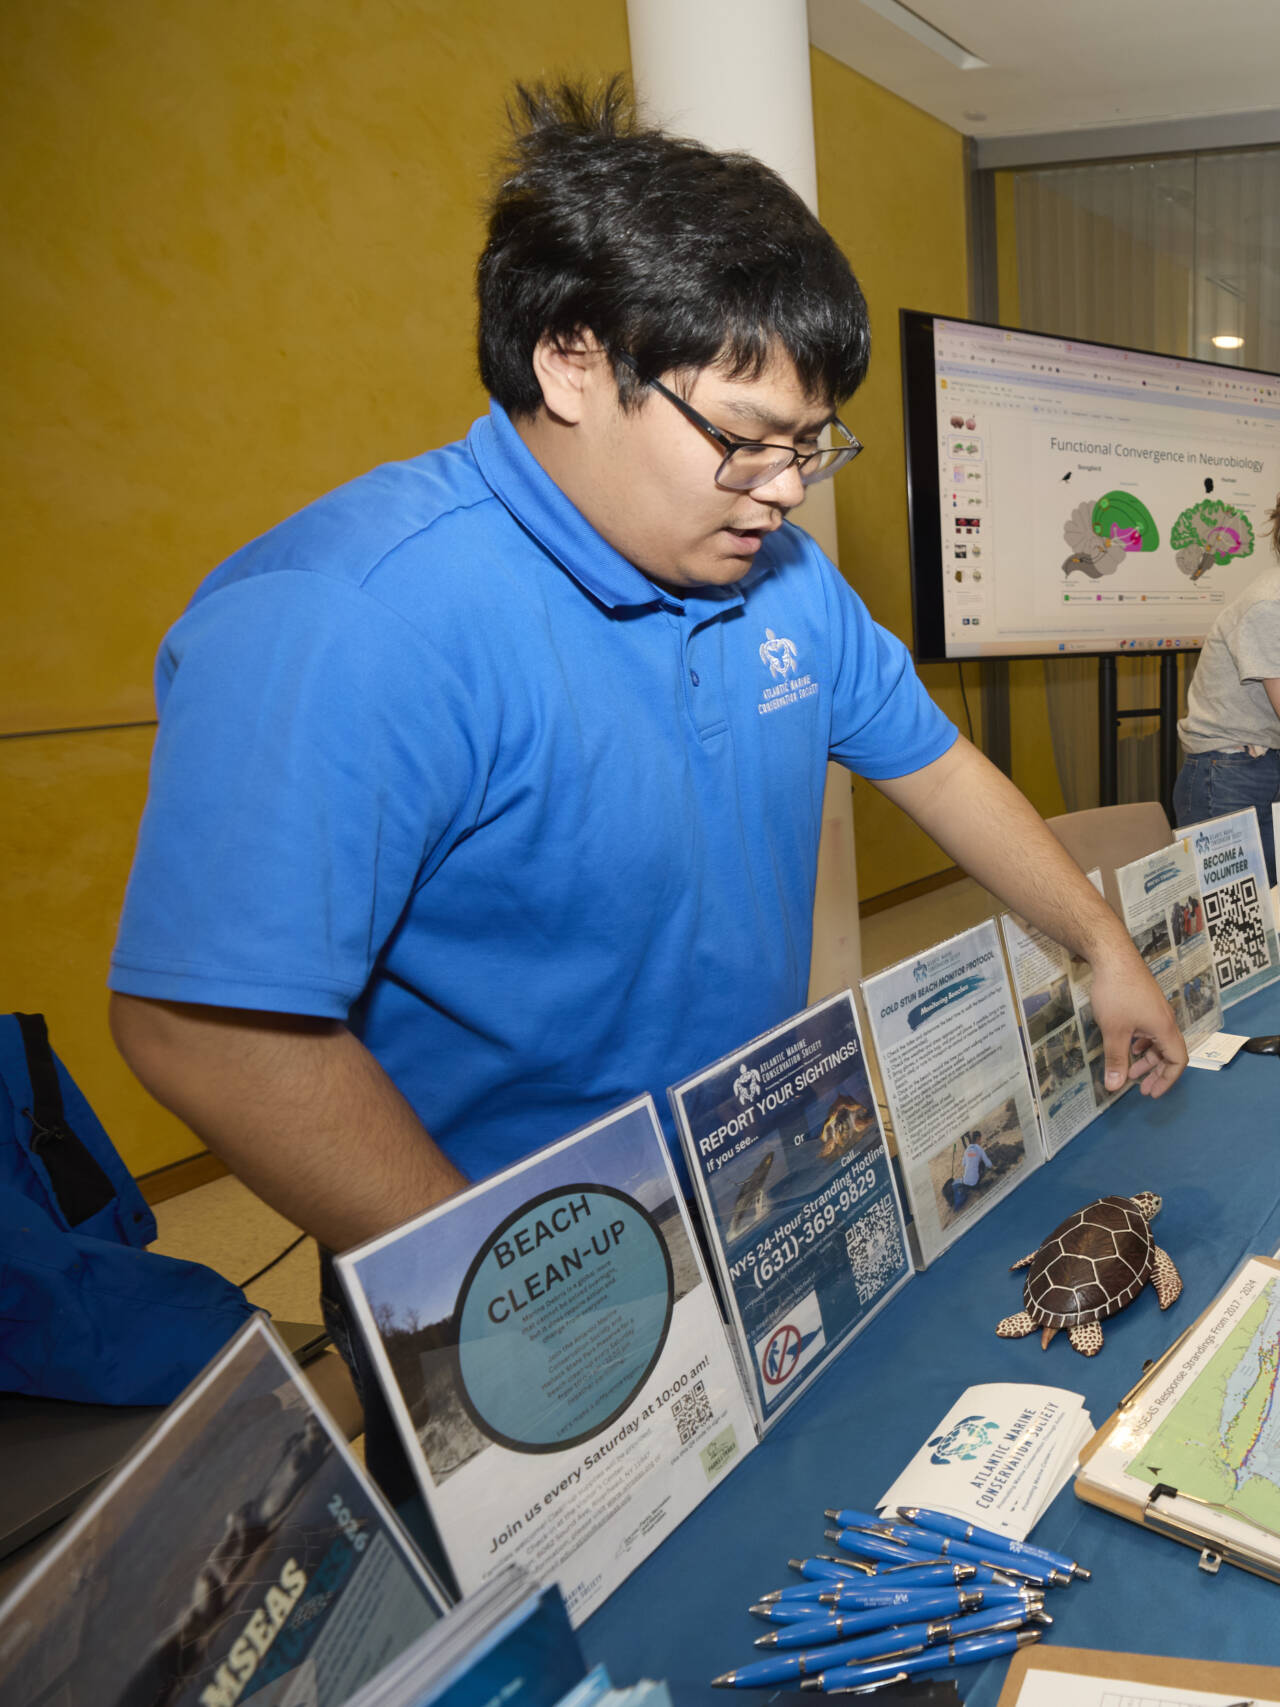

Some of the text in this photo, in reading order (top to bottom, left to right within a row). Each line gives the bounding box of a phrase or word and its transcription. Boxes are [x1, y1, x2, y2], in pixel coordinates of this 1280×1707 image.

[1050, 437, 1264, 472] Functional Convergence in Neurobiology
[758, 683, 818, 714] CONSERVATION SOCIETY
[763, 675, 811, 699] ATLANTIC MARINE
[1203, 846, 1244, 870] BECOME A
[1204, 859, 1248, 885] VOLUNTEER
[879, 1000, 899, 1019] COLD
[898, 990, 917, 1009] STUN
[916, 979, 939, 999] BEACH
[936, 964, 965, 987] MONITOR
[964, 948, 994, 972] PROTOCOL
[919, 982, 969, 1017] Monitoring Beaches
[758, 1050, 785, 1073] ATLANTIC
[785, 1036, 807, 1056] MARINE
[761, 1051, 801, 1083] CONSERVATION
[800, 1038, 822, 1059] SOCIETY
[698, 1105, 757, 1157] REPORT
[755, 1081, 794, 1119] YOUR
[792, 1037, 859, 1092] SIGHTINGS!
[705, 1129, 759, 1173] If you see...
[793, 1130, 806, 1148] Or
[839, 1144, 861, 1169] Call...
[492, 1192, 591, 1270] BEACH
[728, 1140, 885, 1282] NYS 24-Hour Stranding Hotline
[749, 1165, 878, 1291] (631)-369-9829
[484, 1216, 629, 1328] CLEAN-UP
[521, 1302, 545, 1324] Marine
[544, 1288, 567, 1309] Debris
[576, 1268, 596, 1287] global
[528, 1328, 542, 1343] but
[546, 1312, 564, 1330] does
[562, 1296, 587, 1319] require
[585, 1284, 605, 1303] action
[603, 1275, 617, 1290] and
[534, 1304, 559, 1327] cannot
[558, 1298, 568, 1311] be
[567, 1284, 589, 1304] solved
[541, 1322, 566, 1346] change
[1128, 1404, 1161, 1437] MSEAS
[1152, 1369, 1190, 1407] Response
[1180, 1333, 1218, 1371] Strandings
[1208, 1315, 1230, 1335] From
[1222, 1298, 1243, 1317] 2017
[1238, 1278, 1259, 1296] 2024
[486, 1514, 523, 1556] Join
[522, 1497, 543, 1525] us
[541, 1463, 583, 1508] every
[582, 1413, 640, 1472] Saturday
[639, 1400, 655, 1423] at
[654, 1371, 689, 1410] 10:00
[687, 1353, 710, 1381] am!
[970, 1408, 1037, 1489] ATLANTIC MARINE
[976, 1401, 1060, 1509] CONSERVATION SOCIETY
[327, 1493, 370, 1553] 2026
[554, 1517, 577, 1543] Sound
[623, 1466, 633, 1480] NY
[198, 1556, 310, 1706] MSEAS
